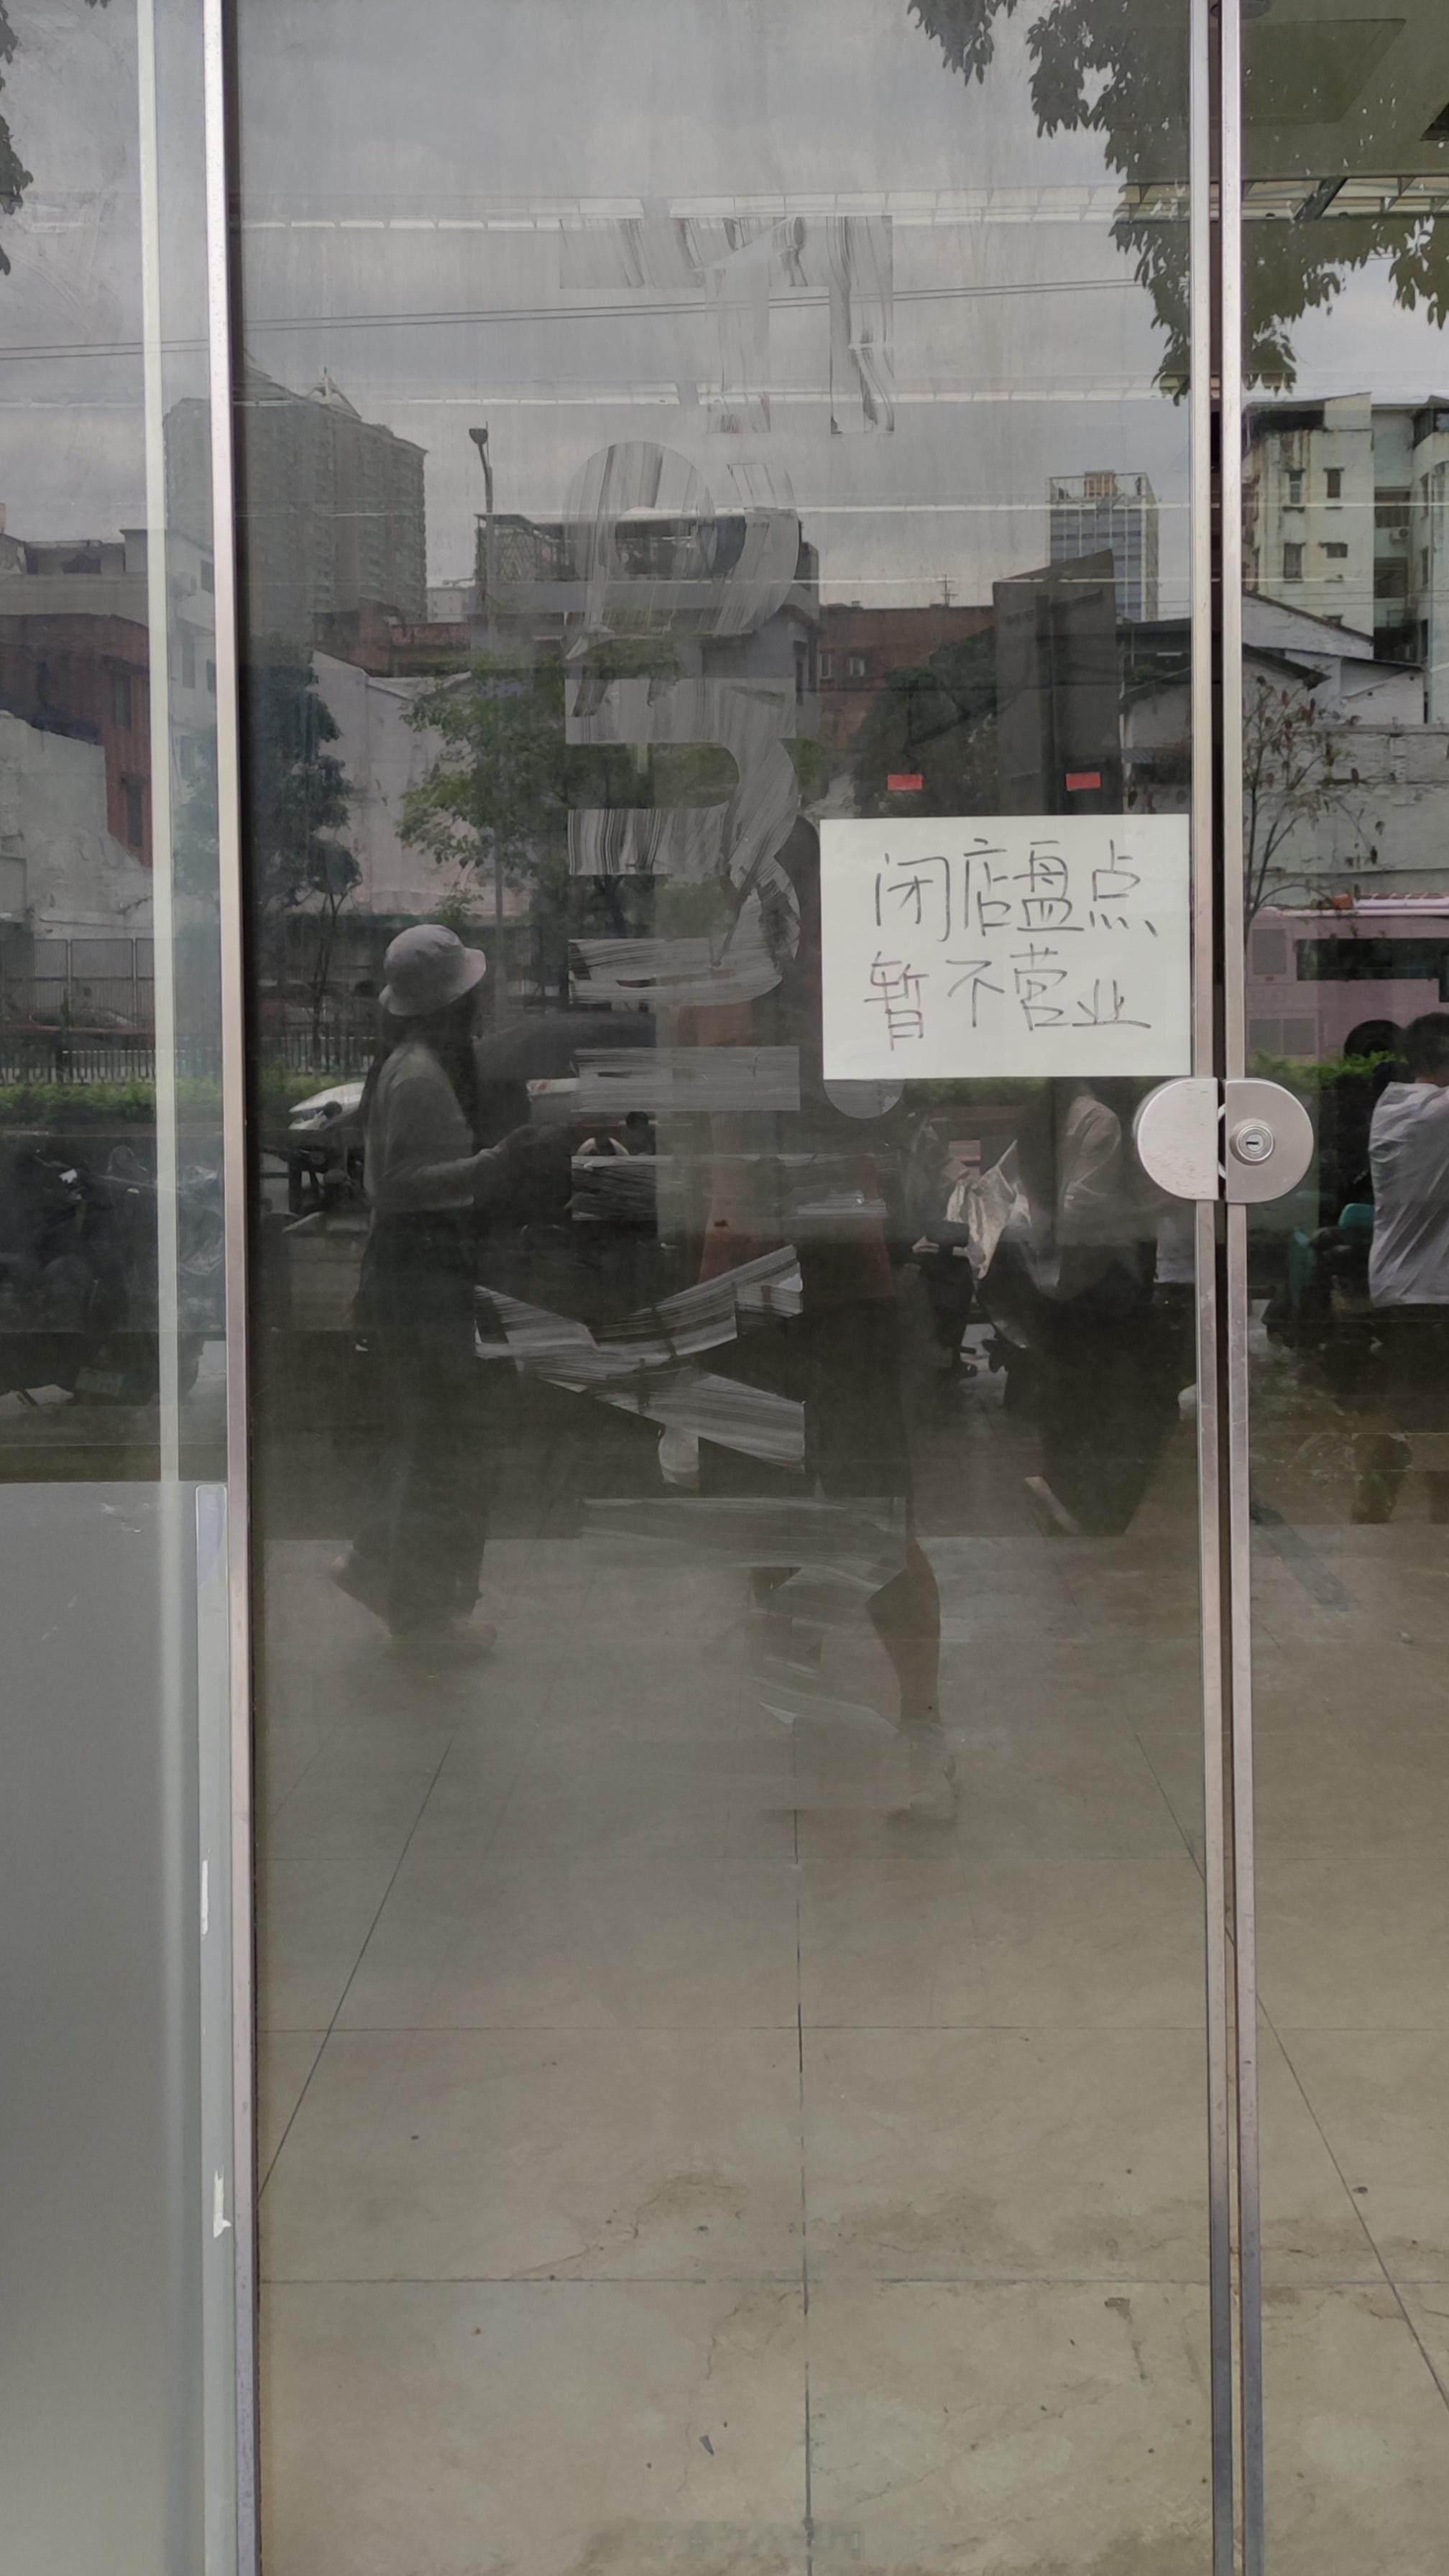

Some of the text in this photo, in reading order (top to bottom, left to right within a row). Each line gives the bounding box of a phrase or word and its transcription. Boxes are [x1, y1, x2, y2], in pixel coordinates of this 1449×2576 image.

[875, 837, 1158, 942] 闭店盘点
[863, 942, 1151, 1052] 暂不营业
